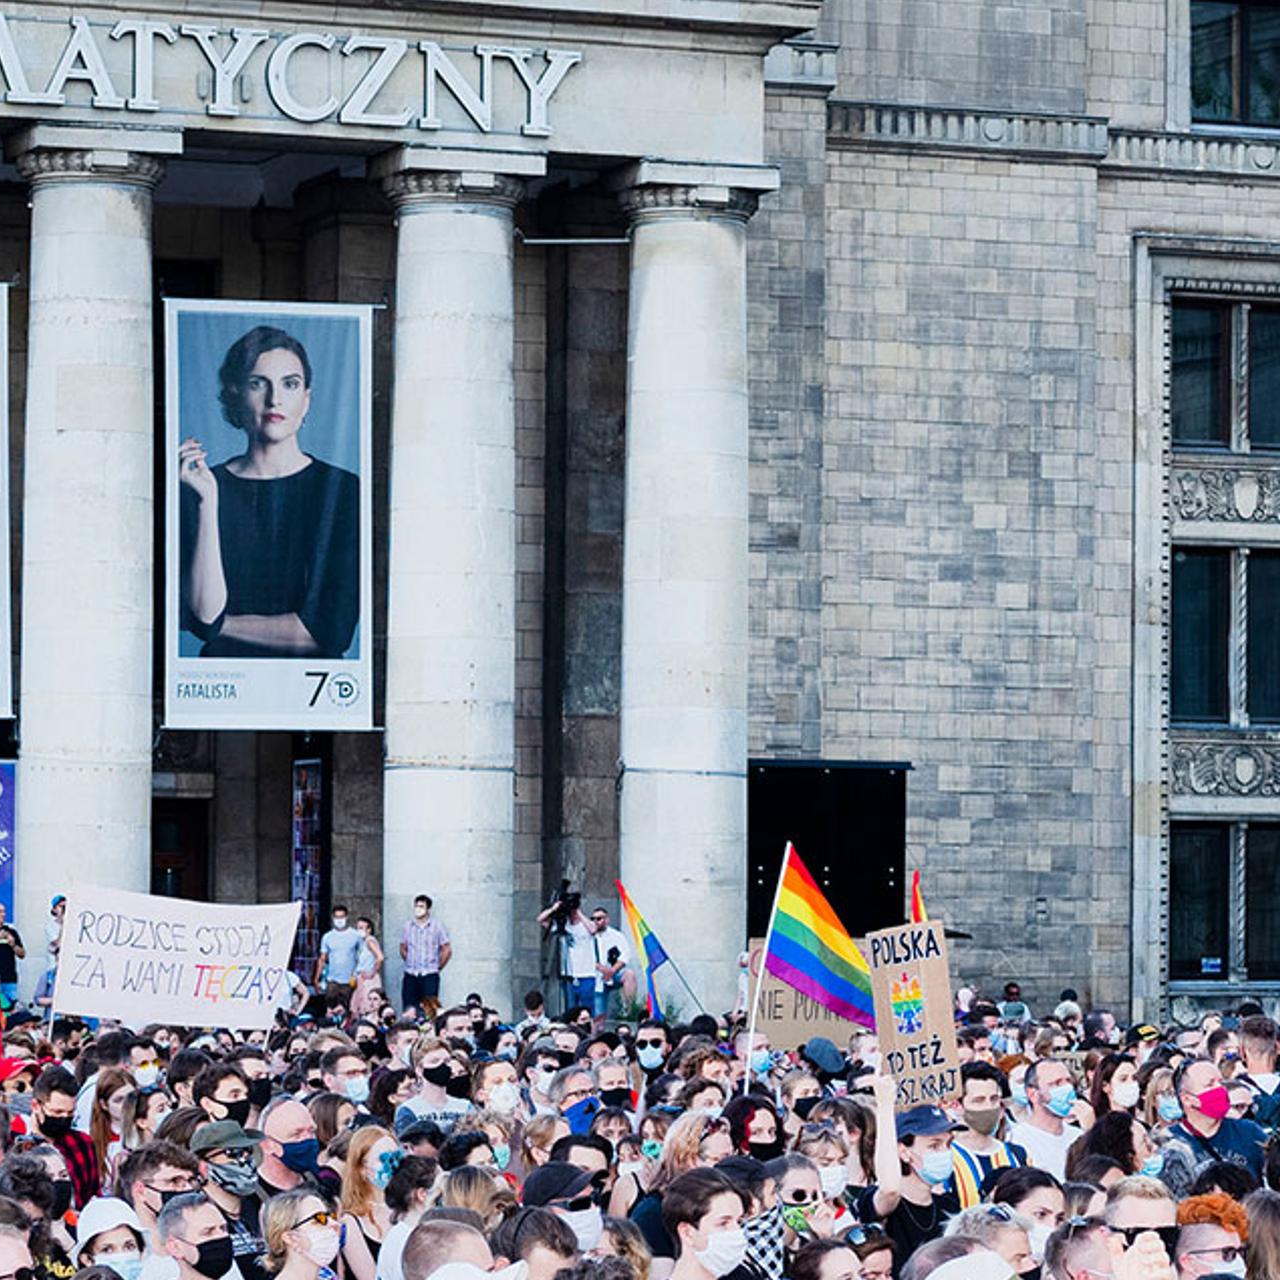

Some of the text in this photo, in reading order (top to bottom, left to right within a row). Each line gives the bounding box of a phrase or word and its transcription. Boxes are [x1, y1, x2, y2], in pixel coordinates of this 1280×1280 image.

[176, 683, 238, 699] FATALISTA
[77, 911, 188, 953] RODZICE
[871, 928, 941, 969] POLSKA
[70, 954, 106, 989] ZA
[121, 959, 184, 996] WAMI
[887, 1033, 946, 1074] TO TEŻ
[921, 1068, 958, 1100] KRAJ
